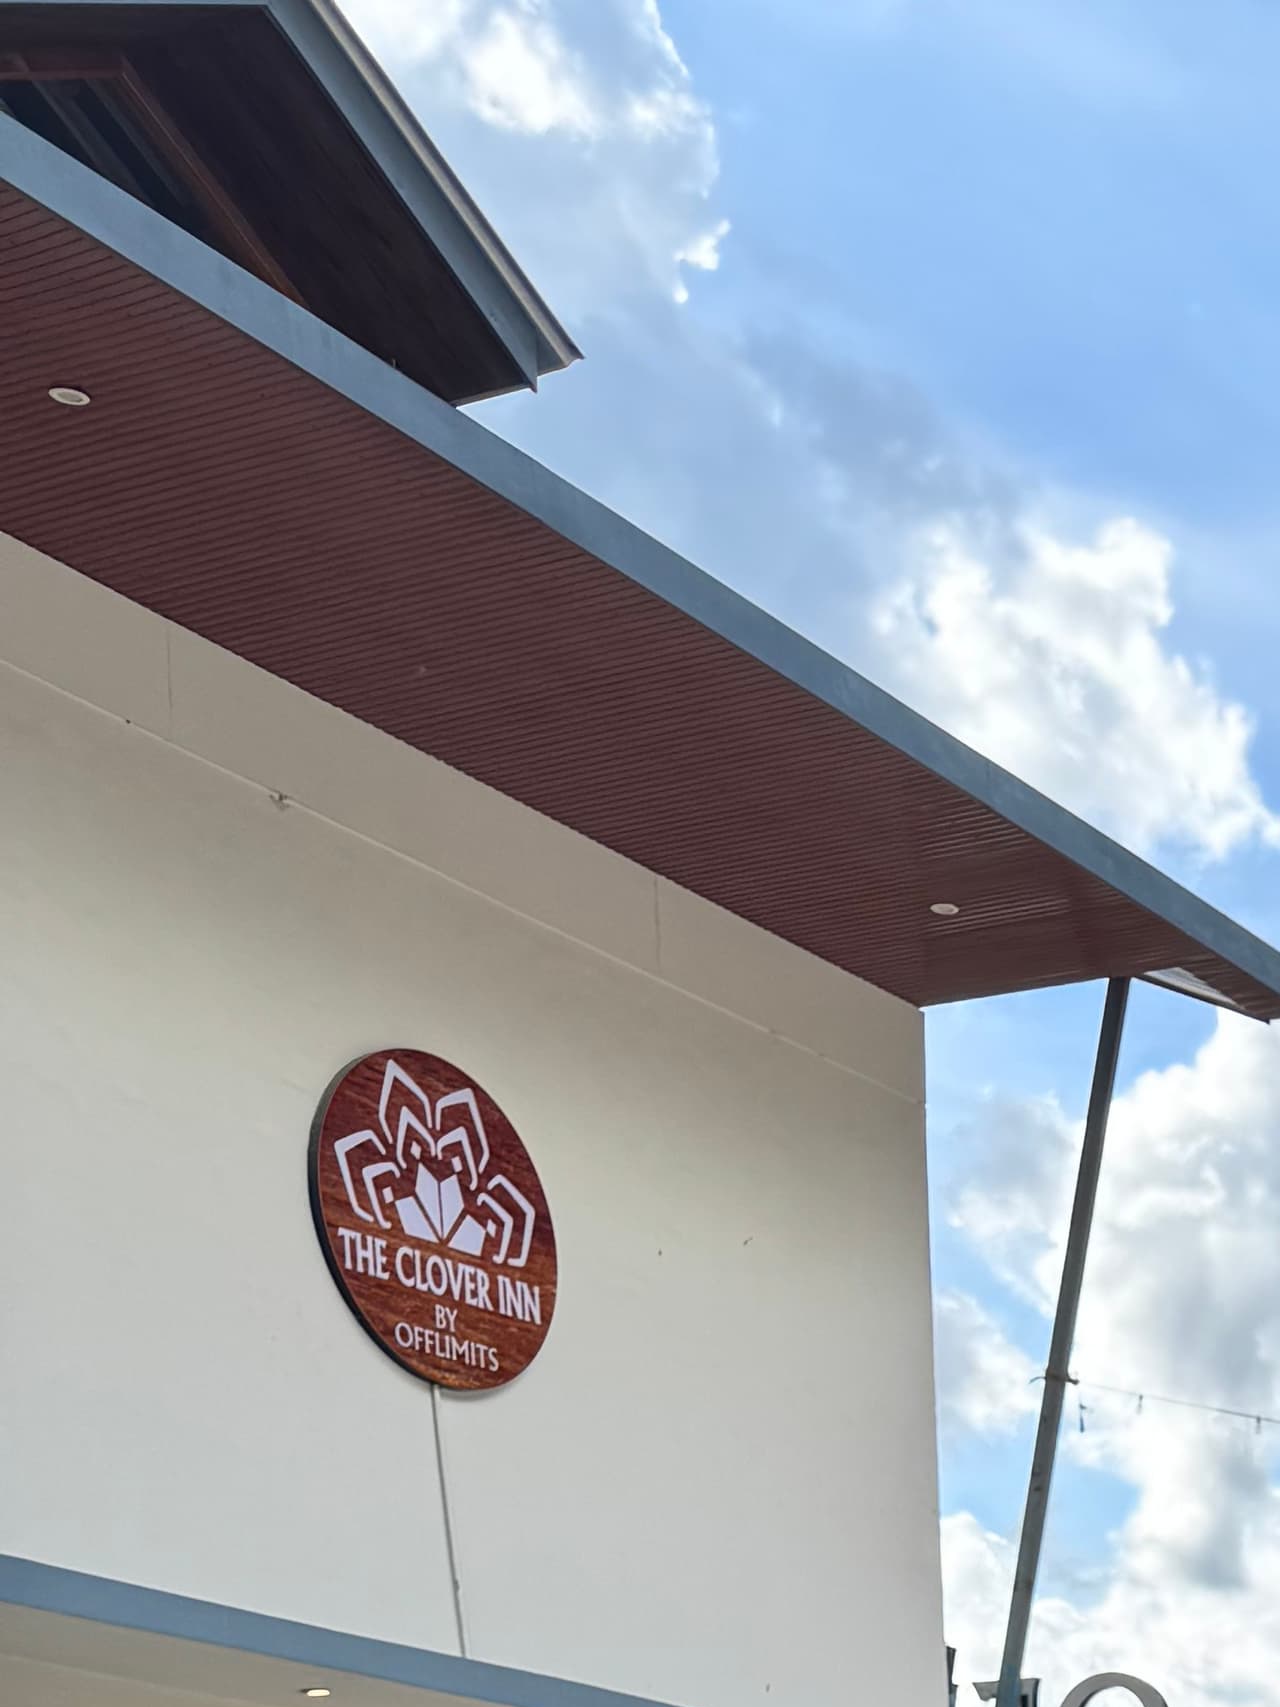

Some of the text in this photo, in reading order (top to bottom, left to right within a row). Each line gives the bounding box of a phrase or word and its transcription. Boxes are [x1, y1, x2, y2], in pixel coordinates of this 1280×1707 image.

[337, 1227, 542, 1325] THE CLOVER INN
[435, 1304, 458, 1333] BY
[395, 1322, 499, 1372] OFFLIMITS
